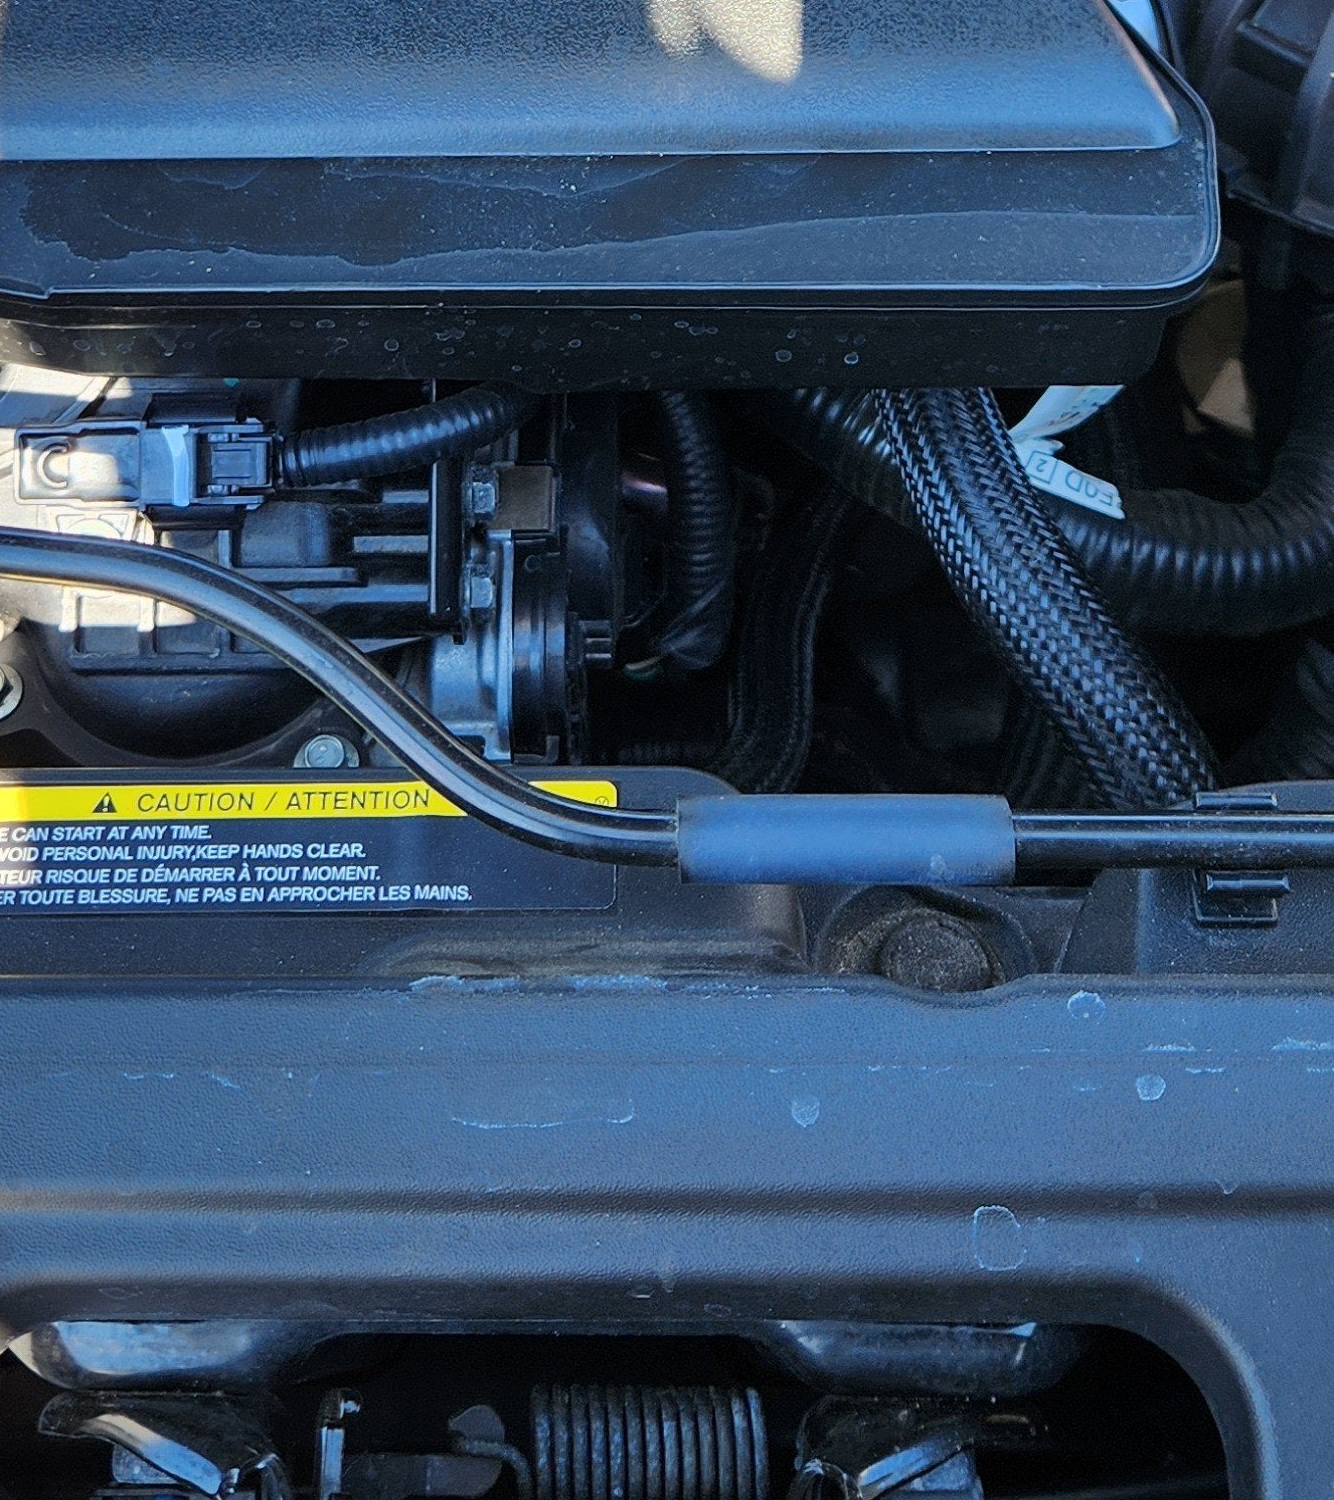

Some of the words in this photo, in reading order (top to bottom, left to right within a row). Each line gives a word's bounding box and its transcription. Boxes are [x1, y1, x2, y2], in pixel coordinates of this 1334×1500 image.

[137, 792, 255, 812] CAUTION
[284, 788, 430, 811] ATTENTION
[11, 826, 47, 842] CAN
[51, 825, 105, 841] START
[106, 825, 128, 841] AT
[130, 824, 167, 841] ANY
[170, 824, 213, 840] TIME.
[41, 845, 135, 861] PERSONAL
[242, 843, 304, 860] HANDS
[306, 842, 368, 859] CLEAR.
[44, 867, 112, 885] RISQUE
[115, 867, 138, 884] DE
[141, 863, 236, 884] DÉMARRER
[237, 862, 252, 883] À
[254, 866, 301, 882] TOUT
[308, 865, 382, 882] MOMENT.
[18, 889, 75, 905] TOUTE
[76, 888, 171, 906] BLESSURE,
[175, 888, 200, 903] NE
[203, 887, 237, 903] PAS
[240, 887, 265, 902] EN
[266, 886, 376, 902] APPROCHER
[377, 885, 411, 901] LES
